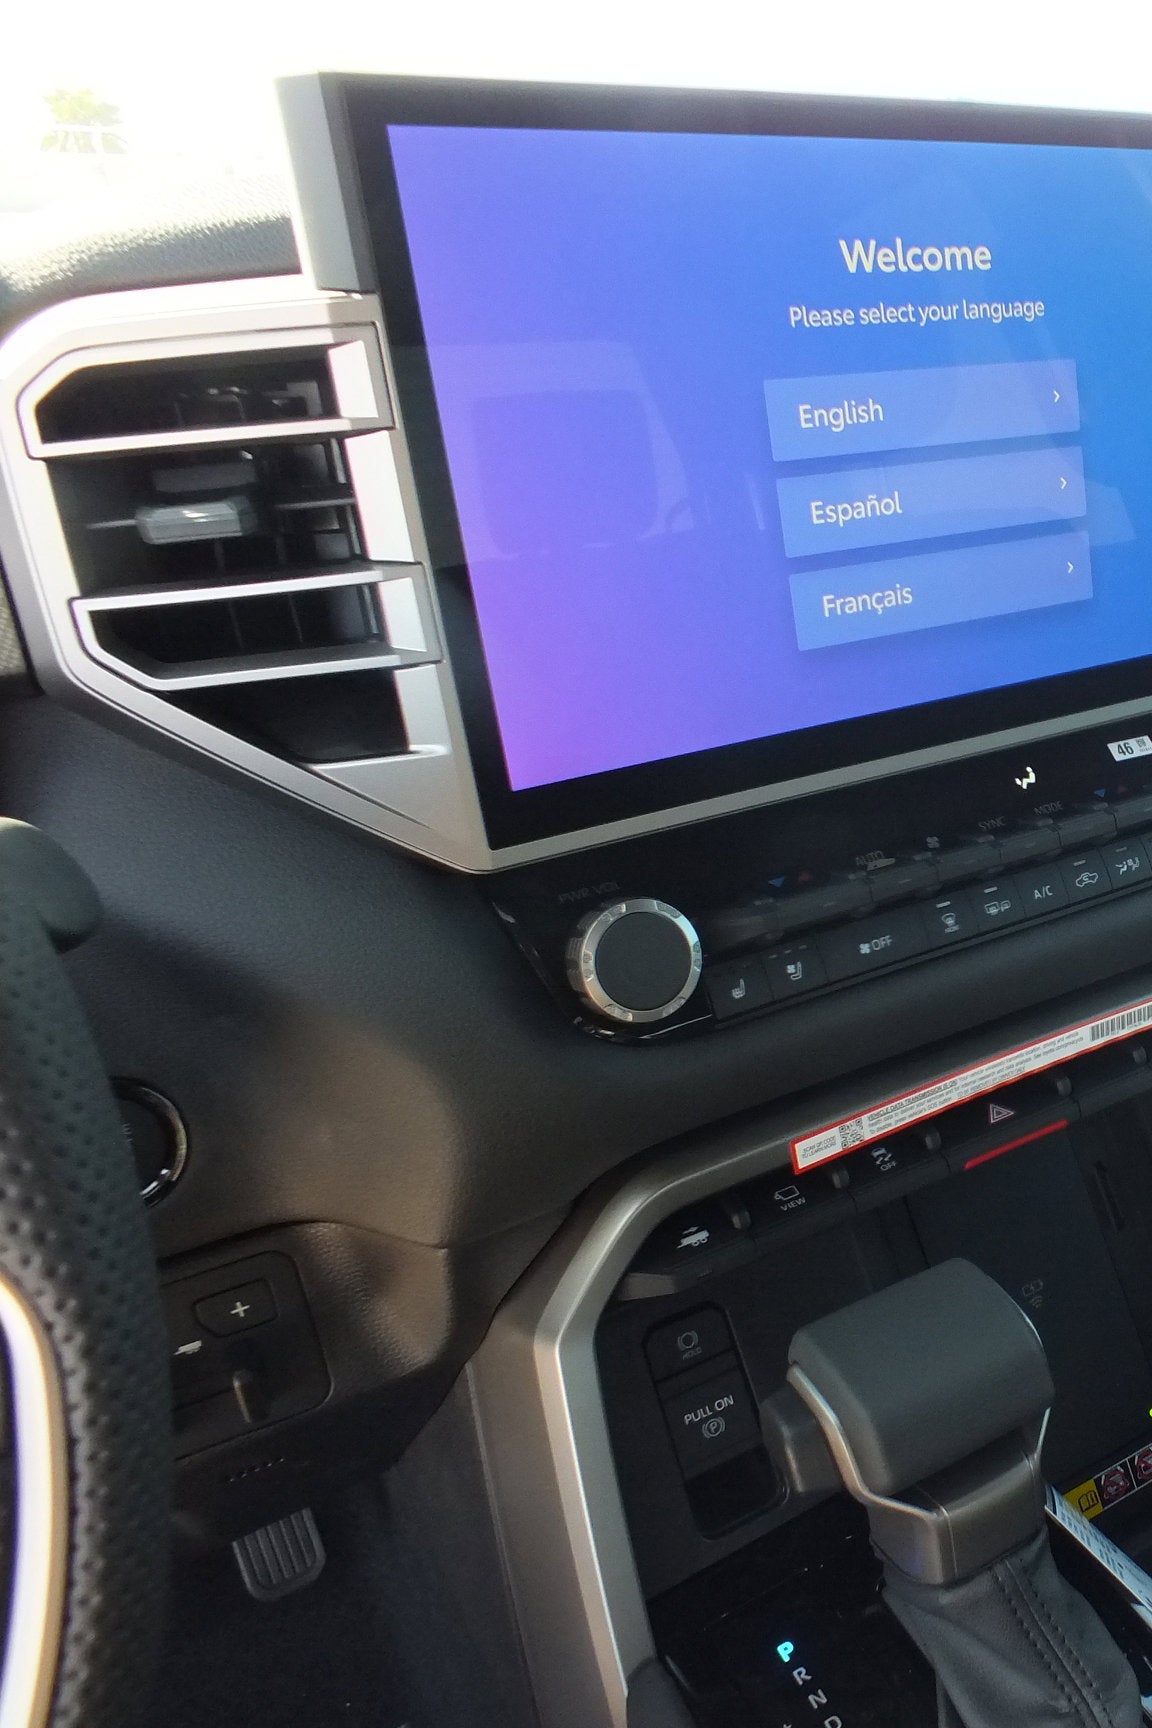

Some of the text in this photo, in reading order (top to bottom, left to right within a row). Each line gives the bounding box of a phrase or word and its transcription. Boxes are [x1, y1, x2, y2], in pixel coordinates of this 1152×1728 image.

[839, 236, 992, 274] Welcome
[789, 299, 1045, 329] Please select your language
[799, 397, 884, 433] English
[810, 491, 903, 527] Español
[822, 583, 913, 618] Français
[1117, 741, 1134, 756] 46
[1033, 800, 1064, 816] MODE
[979, 815, 1007, 831] SYNC
[856, 850, 884, 867] AUTO
[1033, 885, 1053, 899] A/C
[872, 935, 893, 950] OFF
[880, 1160, 898, 1172] OFF
[780, 1196, 806, 1212] VIEW
[684, 1394, 734, 1426] PULL ON
[777, 1641, 794, 1663] P
[793, 1666, 812, 1685] R
[808, 1689, 828, 1709] N
